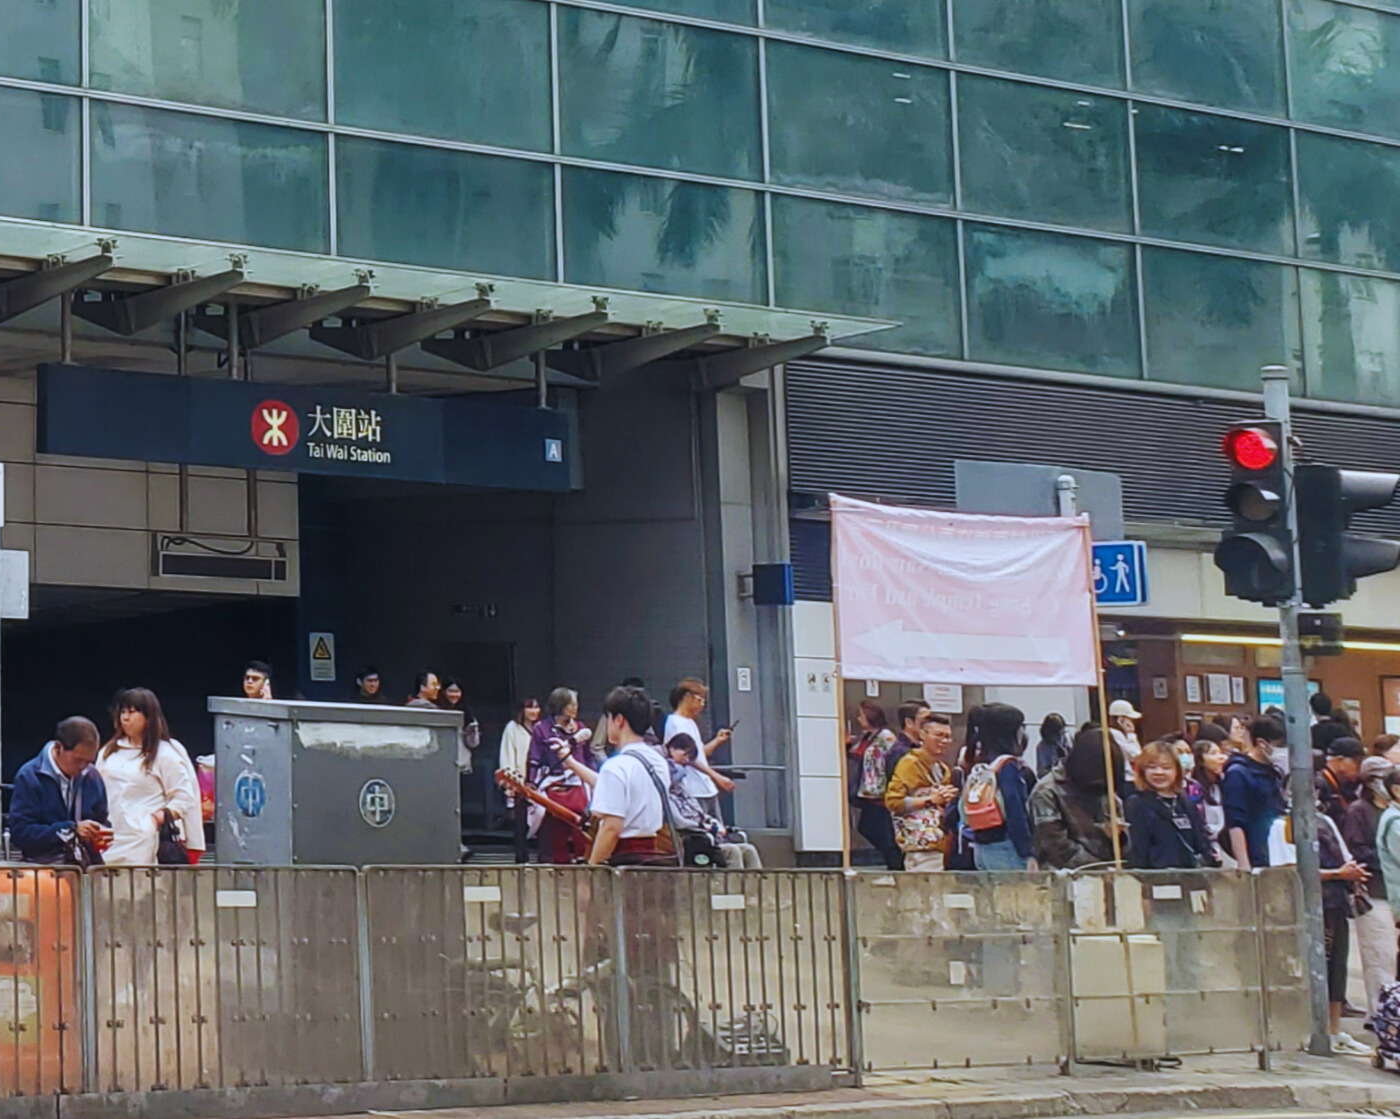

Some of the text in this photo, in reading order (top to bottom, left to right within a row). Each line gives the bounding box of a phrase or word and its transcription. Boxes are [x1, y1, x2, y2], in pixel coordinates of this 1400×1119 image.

[307, 405, 382, 442] 大圍站
[307, 442, 391, 463] Tai Wai Station
[548, 443, 558, 459] A
